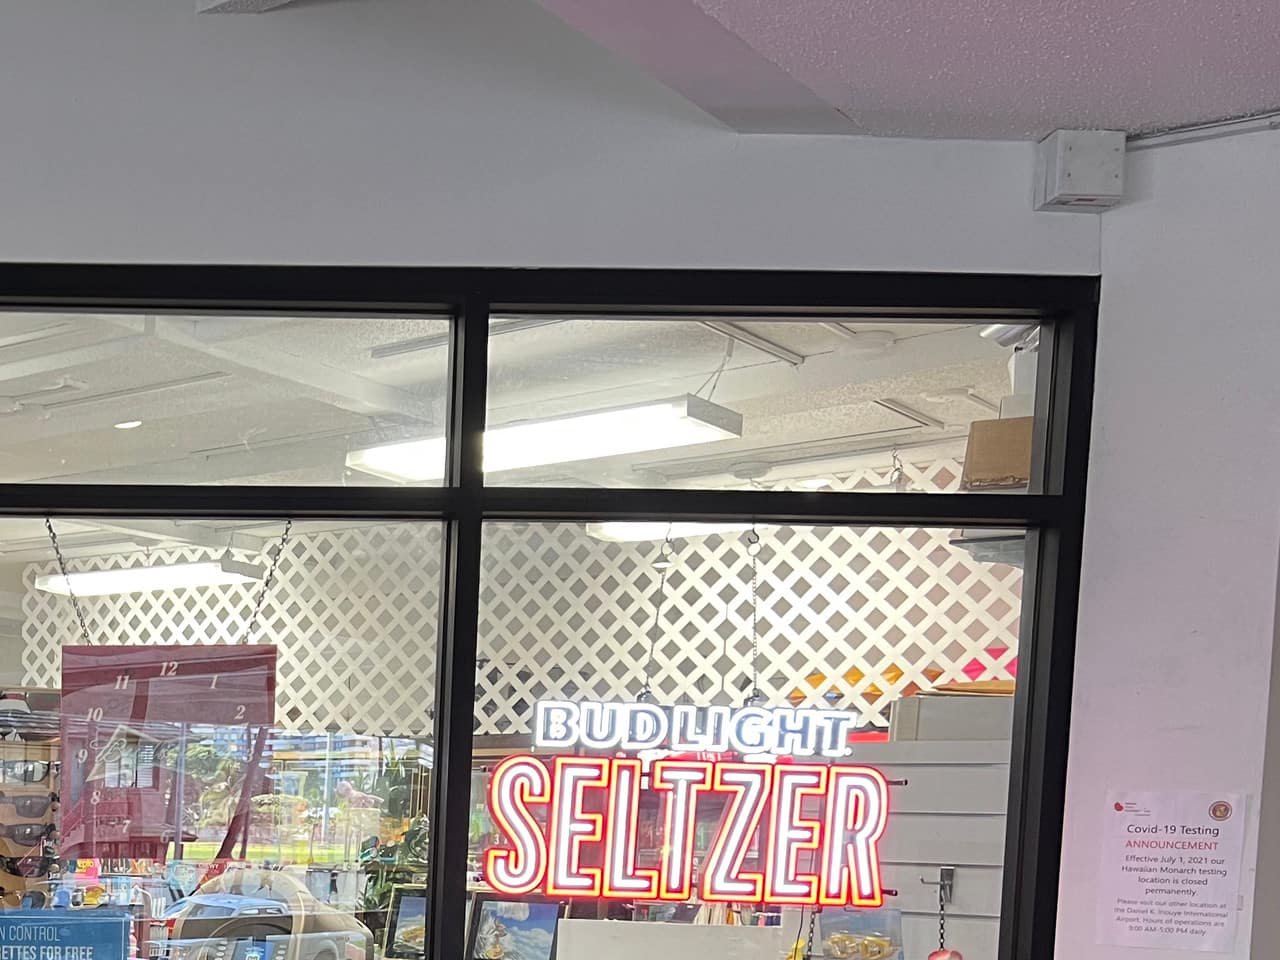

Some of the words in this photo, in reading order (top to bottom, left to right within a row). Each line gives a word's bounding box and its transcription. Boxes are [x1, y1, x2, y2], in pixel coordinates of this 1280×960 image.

[160, 662, 179, 676] 12
[114, 675, 131, 690] 11
[209, 675, 218, 689] 1
[86, 707, 104, 721] 10
[234, 705, 246, 719] 2
[535, 700, 669, 749] BUD
[672, 704, 858, 757] LIGHT
[78, 750, 88, 763] 9
[90, 791, 101, 804] 8
[487, 755, 888, 906] SELTZER
[1127, 824, 1176, 833] Covid-19
[1180, 825, 1220, 837] Testing
[1125, 840, 1218, 850] ANNOUNCEMENT
[1161, 856, 1176, 864] July
[1199, 869, 1227, 877] testing
[9, 926, 61, 942] CONTROL
[40, 946, 62, 960] FOR
[64, 946, 93, 960] FREE
